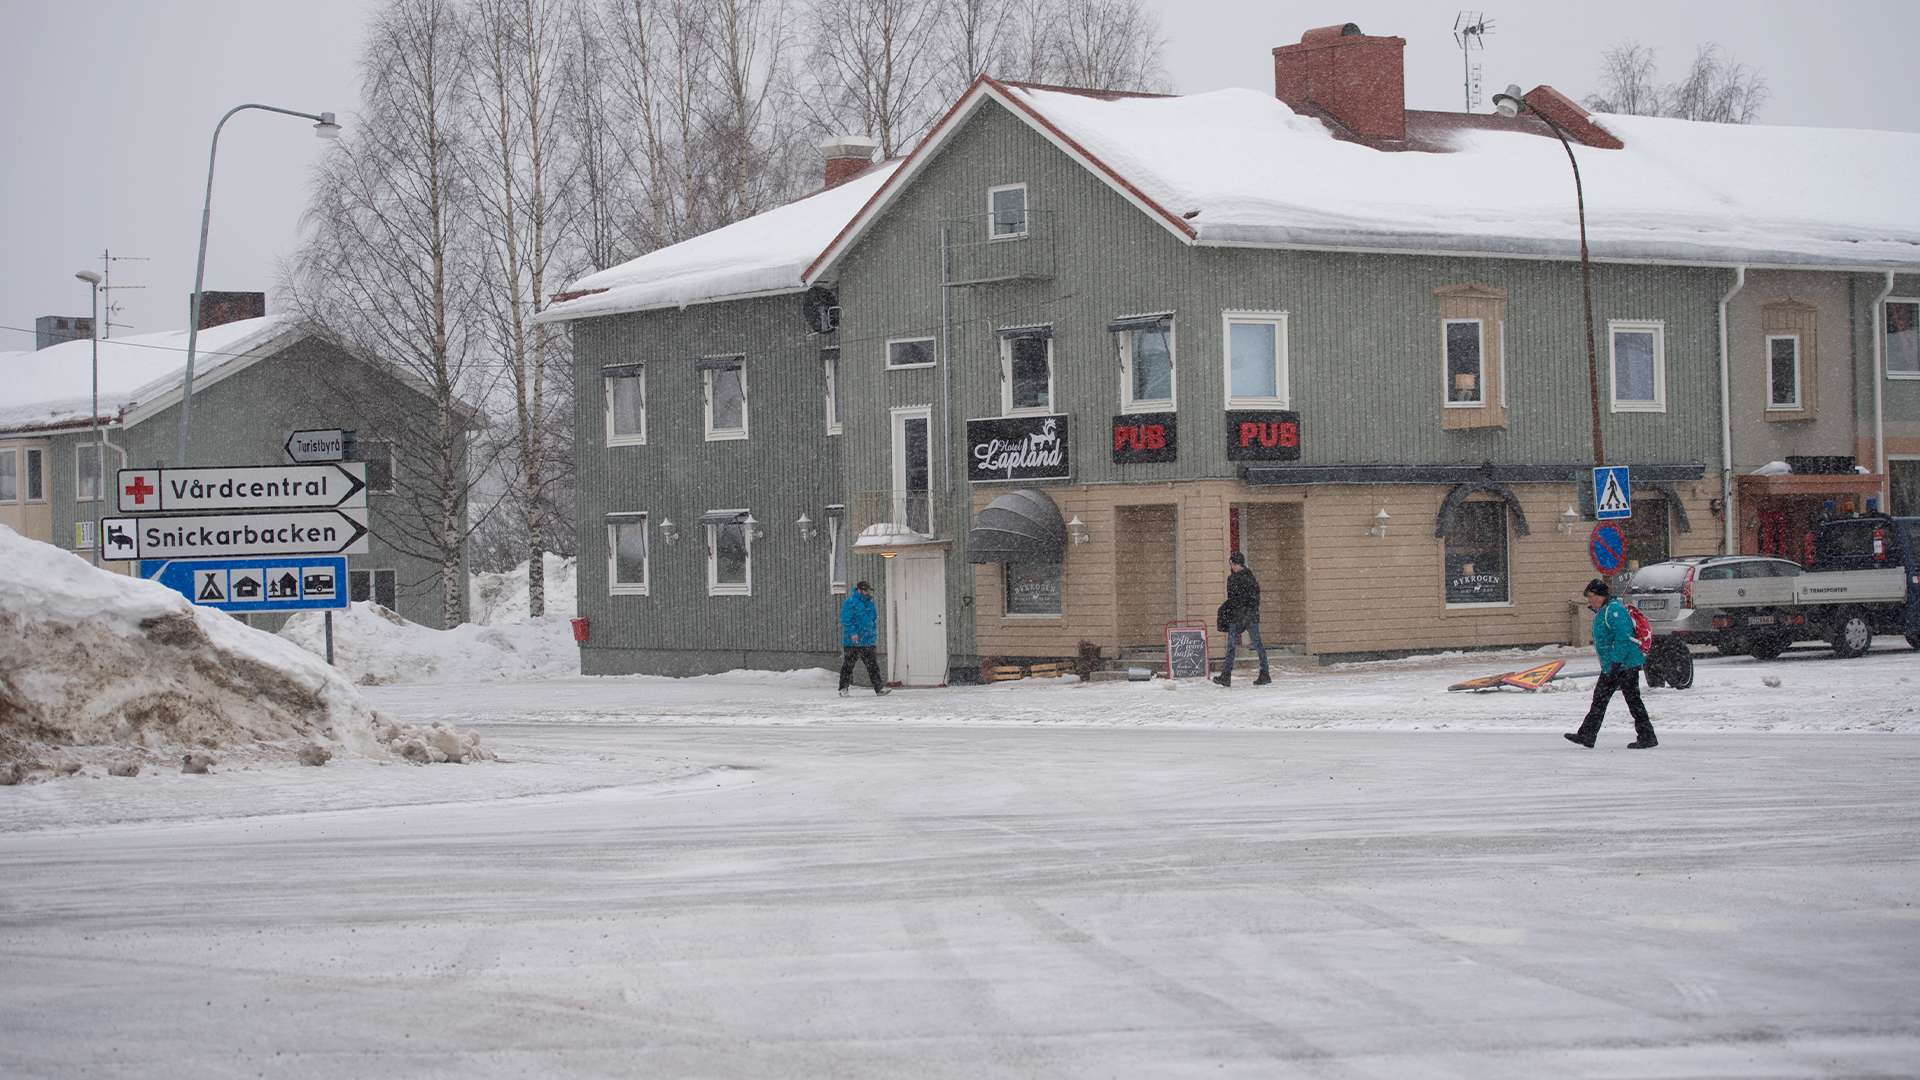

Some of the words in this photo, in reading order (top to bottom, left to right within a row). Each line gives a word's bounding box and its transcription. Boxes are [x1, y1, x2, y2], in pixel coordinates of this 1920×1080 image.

[1000, 440, 1022, 452] Hotel
[1114, 425, 1166, 450] PUB
[1239, 422, 1298, 447] PUB
[297, 438, 340, 455] Turistbyrå
[974, 437, 1063, 479] Lapland
[171, 476, 327, 499] Vårdcentral
[146, 523, 336, 548] Snickarbacken
[1014, 583, 1056, 594] BYKROGEN
[1453, 574, 1500, 587] BYKROGEN
